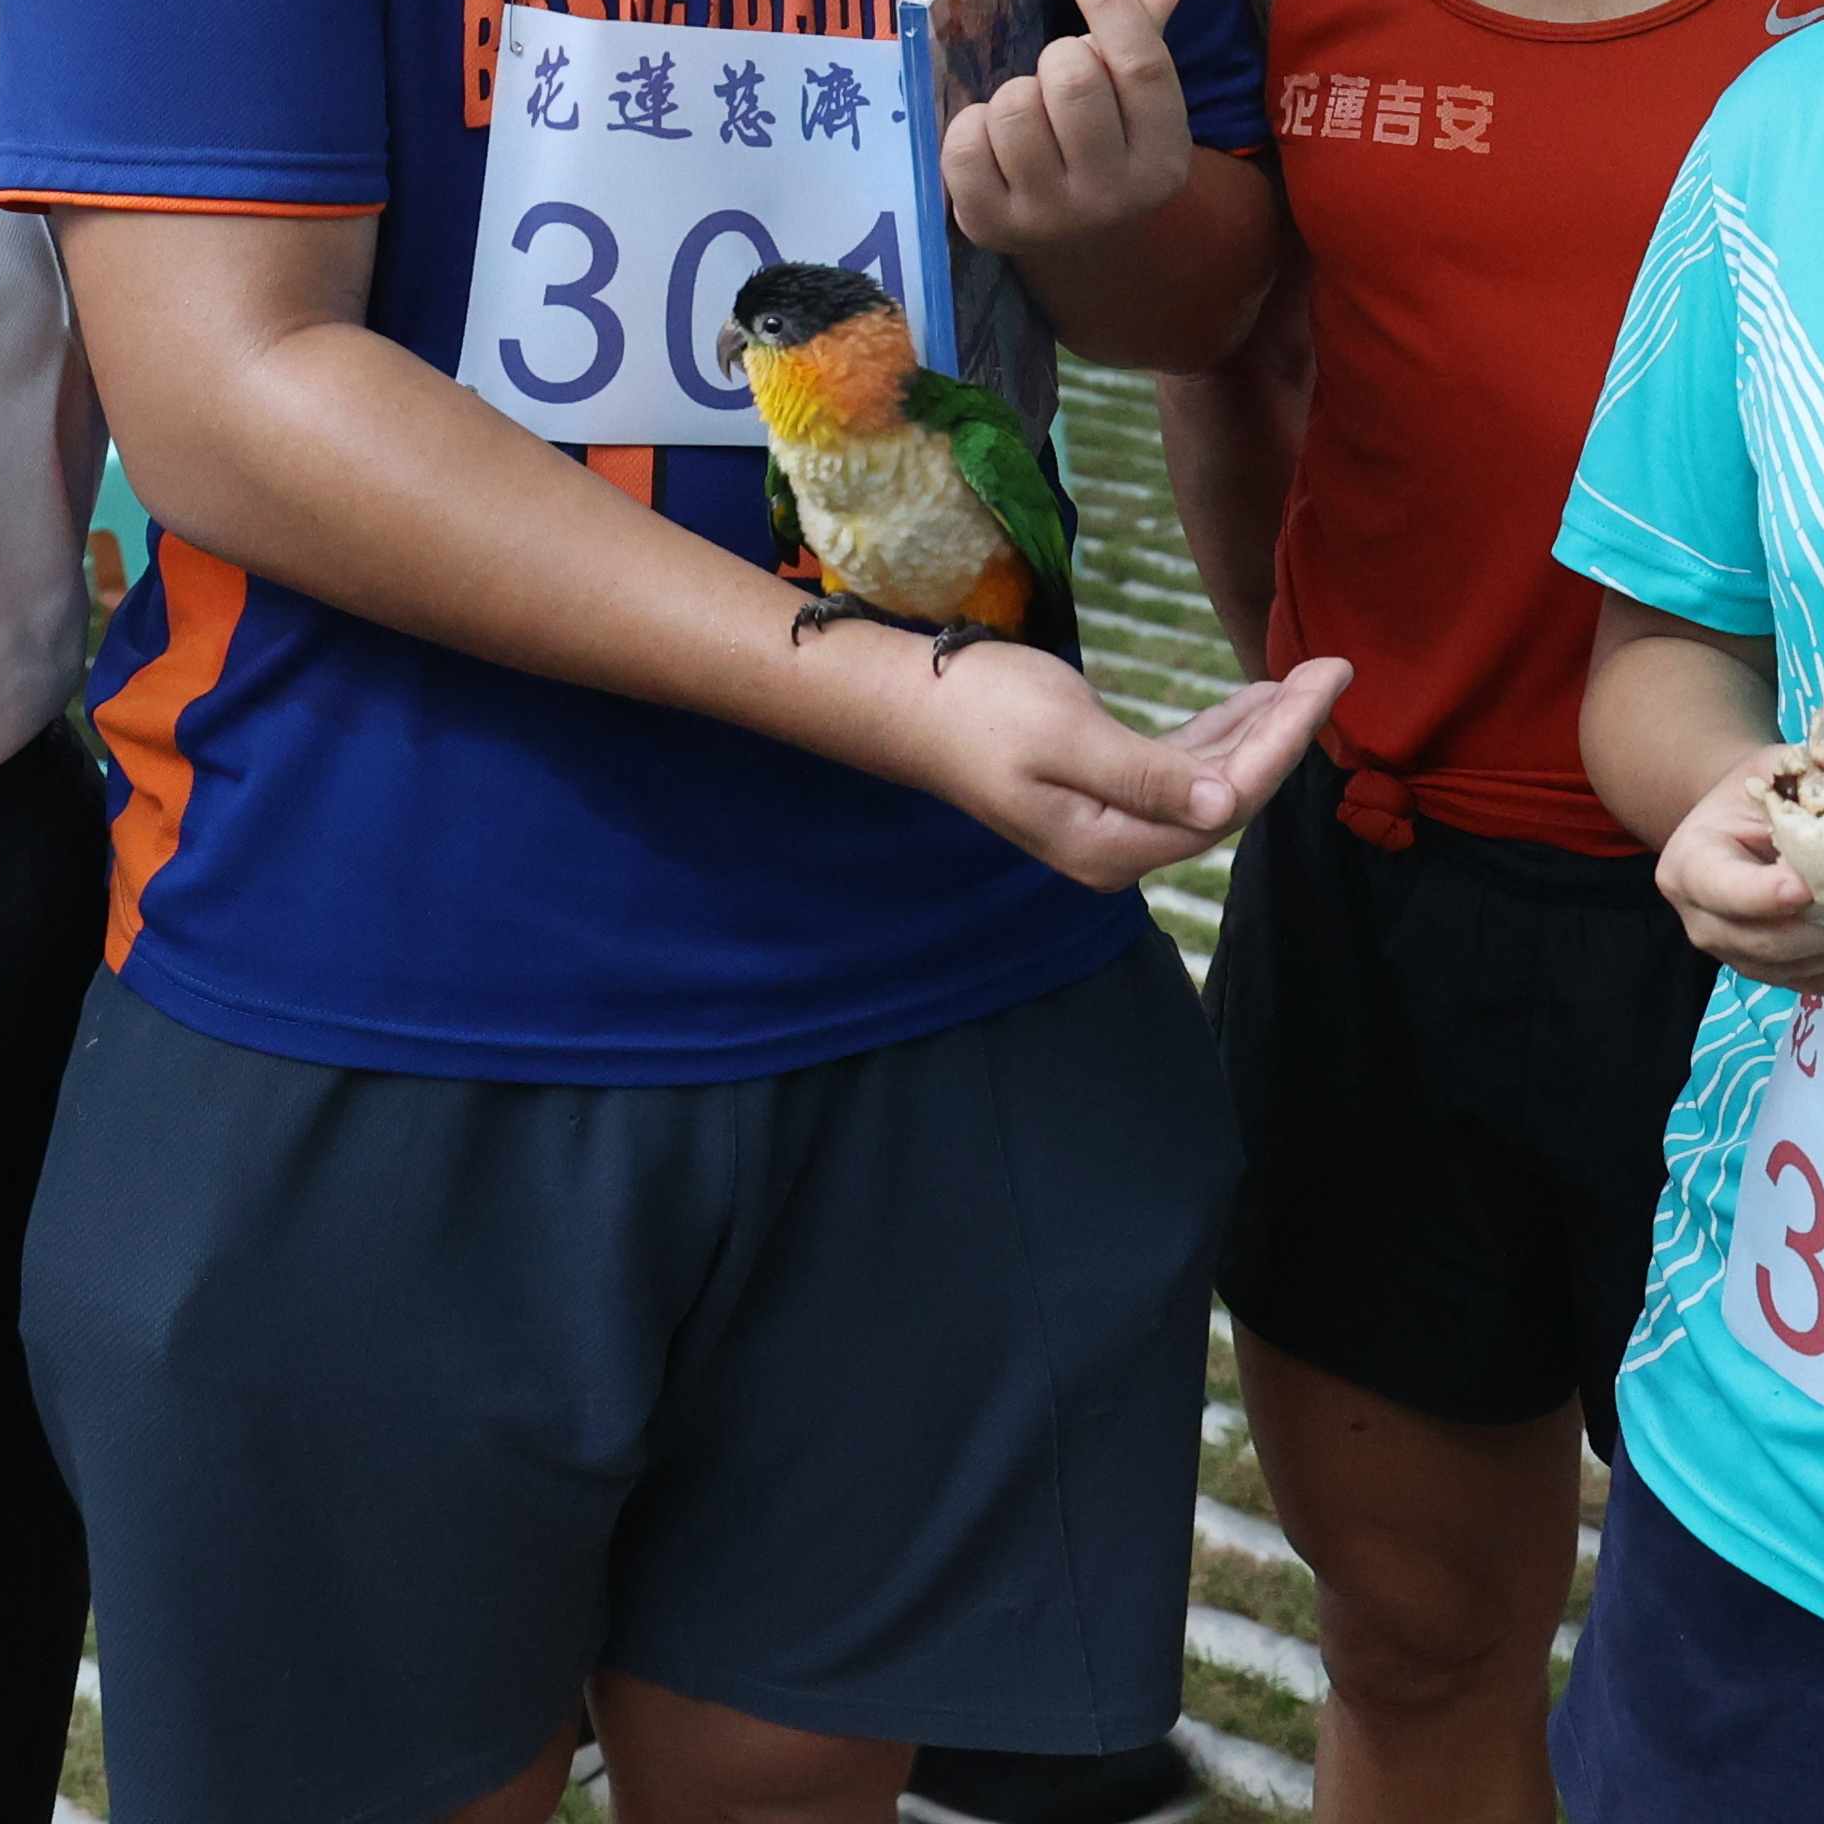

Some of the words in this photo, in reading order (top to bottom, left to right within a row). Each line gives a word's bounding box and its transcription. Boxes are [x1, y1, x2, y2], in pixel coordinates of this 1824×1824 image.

[526, 44, 908, 151] 花蓮慈濟
[1279, 72, 1494, 154] 花蓮吉安
